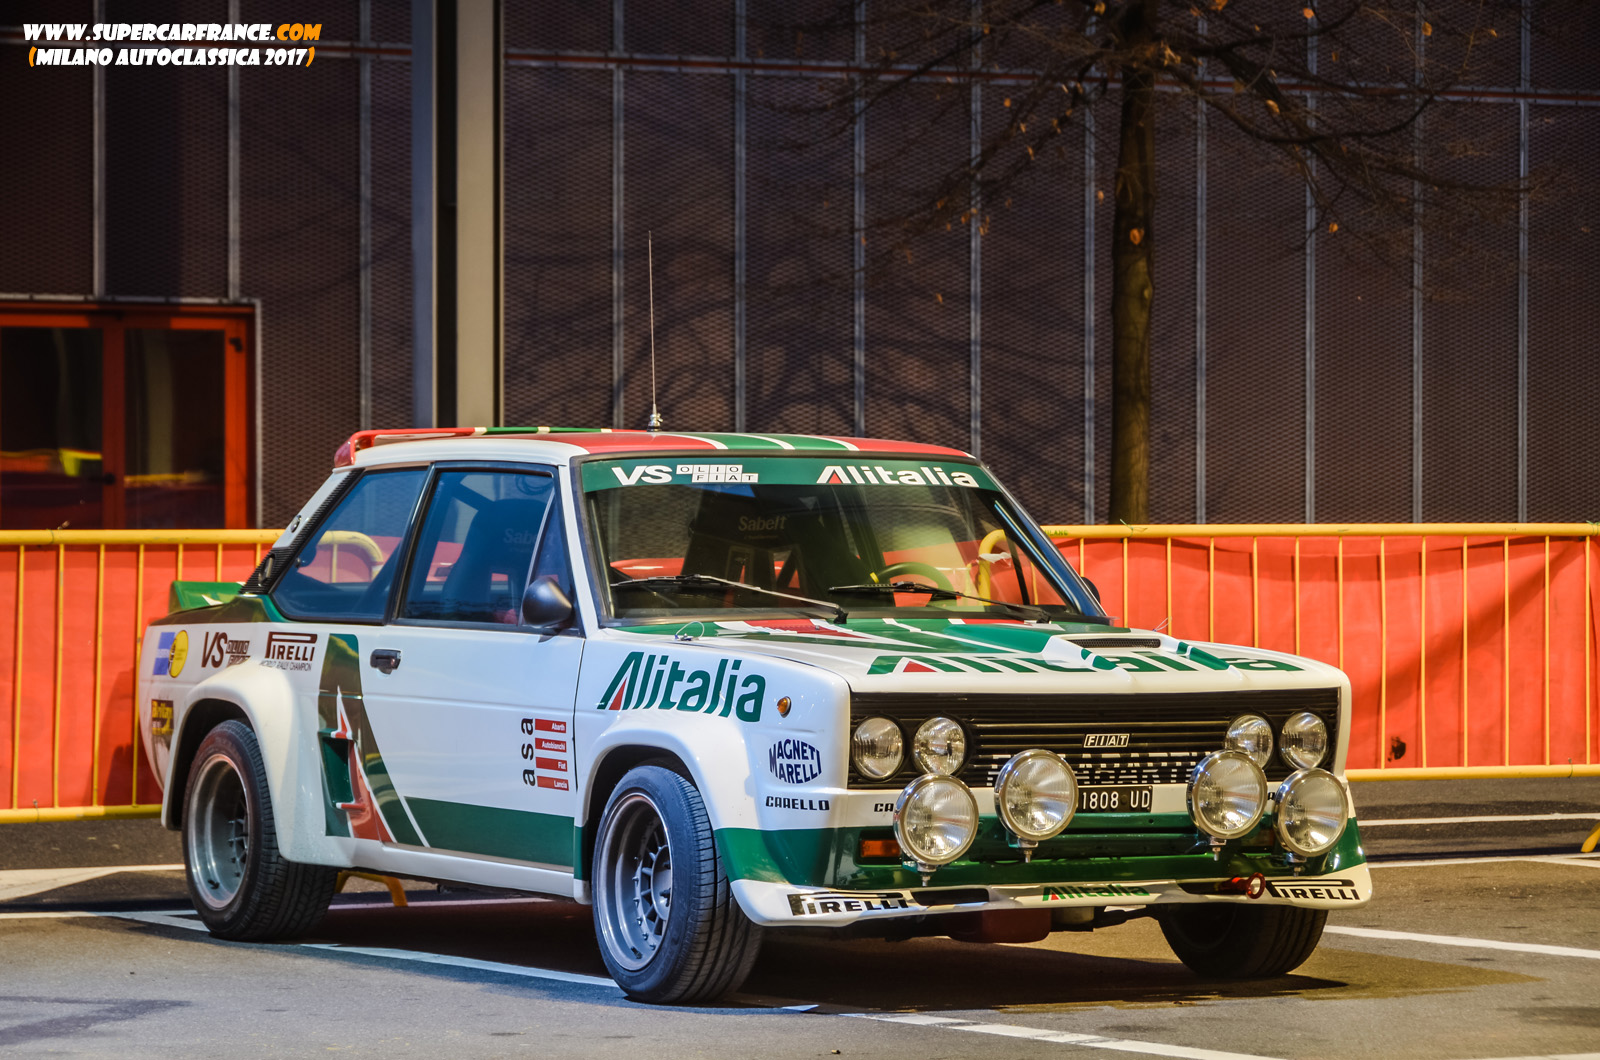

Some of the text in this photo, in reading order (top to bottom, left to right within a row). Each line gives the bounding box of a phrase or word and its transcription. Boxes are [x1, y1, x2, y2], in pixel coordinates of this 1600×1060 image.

[611, 465, 673, 486] VS
[679, 465, 741, 474] OLIO
[816, 465, 980, 488] Alitalia
[738, 515, 787, 531] Sabelt
[201, 631, 228, 668] VS
[264, 631, 318, 662] PIRELLI
[867, 642, 1306, 676] Alitalia
[597, 651, 766, 722] Alitalia
[551, 722, 566, 731] Abarth
[541, 740, 566, 750] Autobianchi
[1086, 734, 1128, 747] FIAT
[768, 739, 822, 762] MAGNETI
[557, 761, 567, 769] Fiat
[768, 762, 822, 784] MARELLI
[553, 780, 568, 789] Lancia
[765, 796, 830, 811] CARELLO
[1130, 790, 1150, 808] UD
[1042, 884, 1150, 901] Alitalia
[1265, 879, 1360, 900] PIRELLI
[787, 892, 909, 916] PIRELLI
